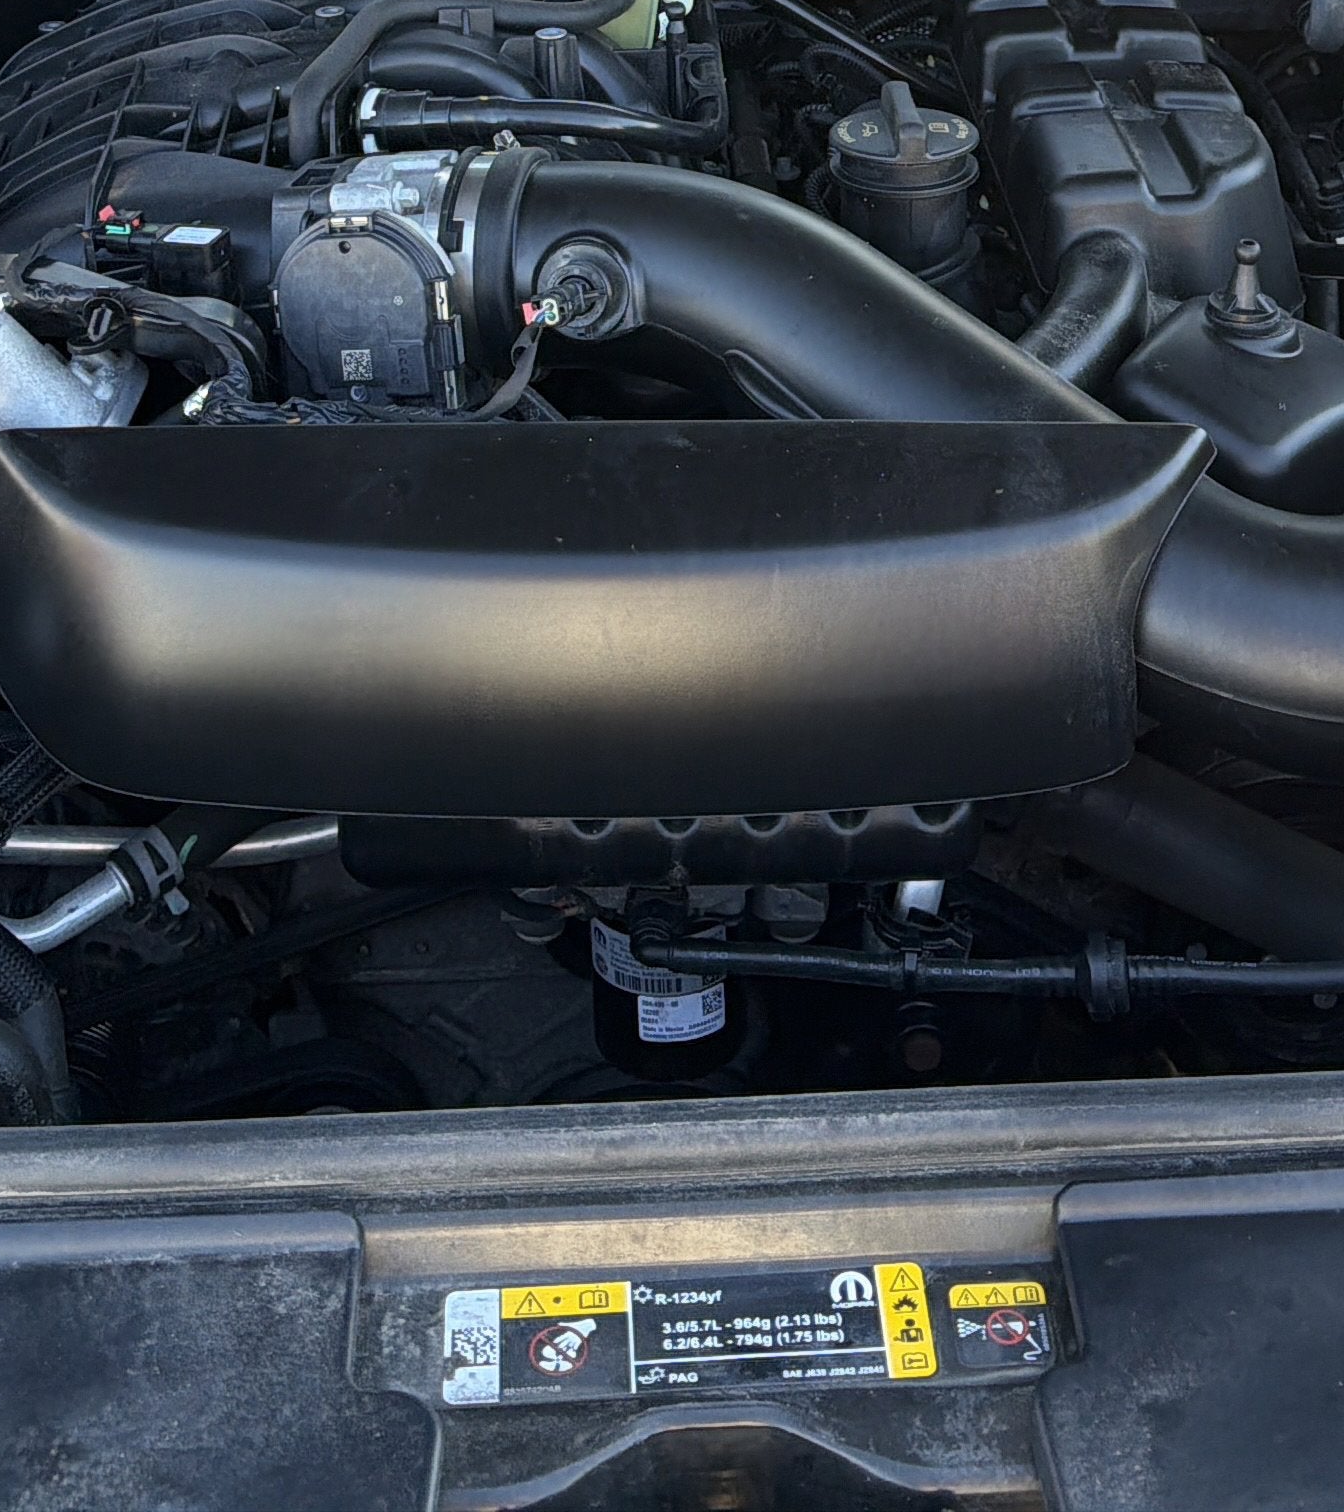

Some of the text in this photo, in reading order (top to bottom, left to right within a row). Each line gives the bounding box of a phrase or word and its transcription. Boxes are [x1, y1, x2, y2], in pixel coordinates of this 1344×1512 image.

[654, 1290, 723, 1306] R-1234yf
[662, 1319, 723, 1335] 3.6/5.7L
[733, 1317, 772, 1331] 964g
[775, 1314, 811, 1330] (2.13
[814, 1312, 843, 1327] lbs)
[662, 1336, 724, 1351] 6.2/6.4L
[735, 1334, 773, 1348] 794g
[777, 1331, 813, 1346] (1.75
[815, 1329, 845, 1343] lbs)
[668, 1372, 699, 1384] PAG
[782, 1369, 803, 1379] SAE
